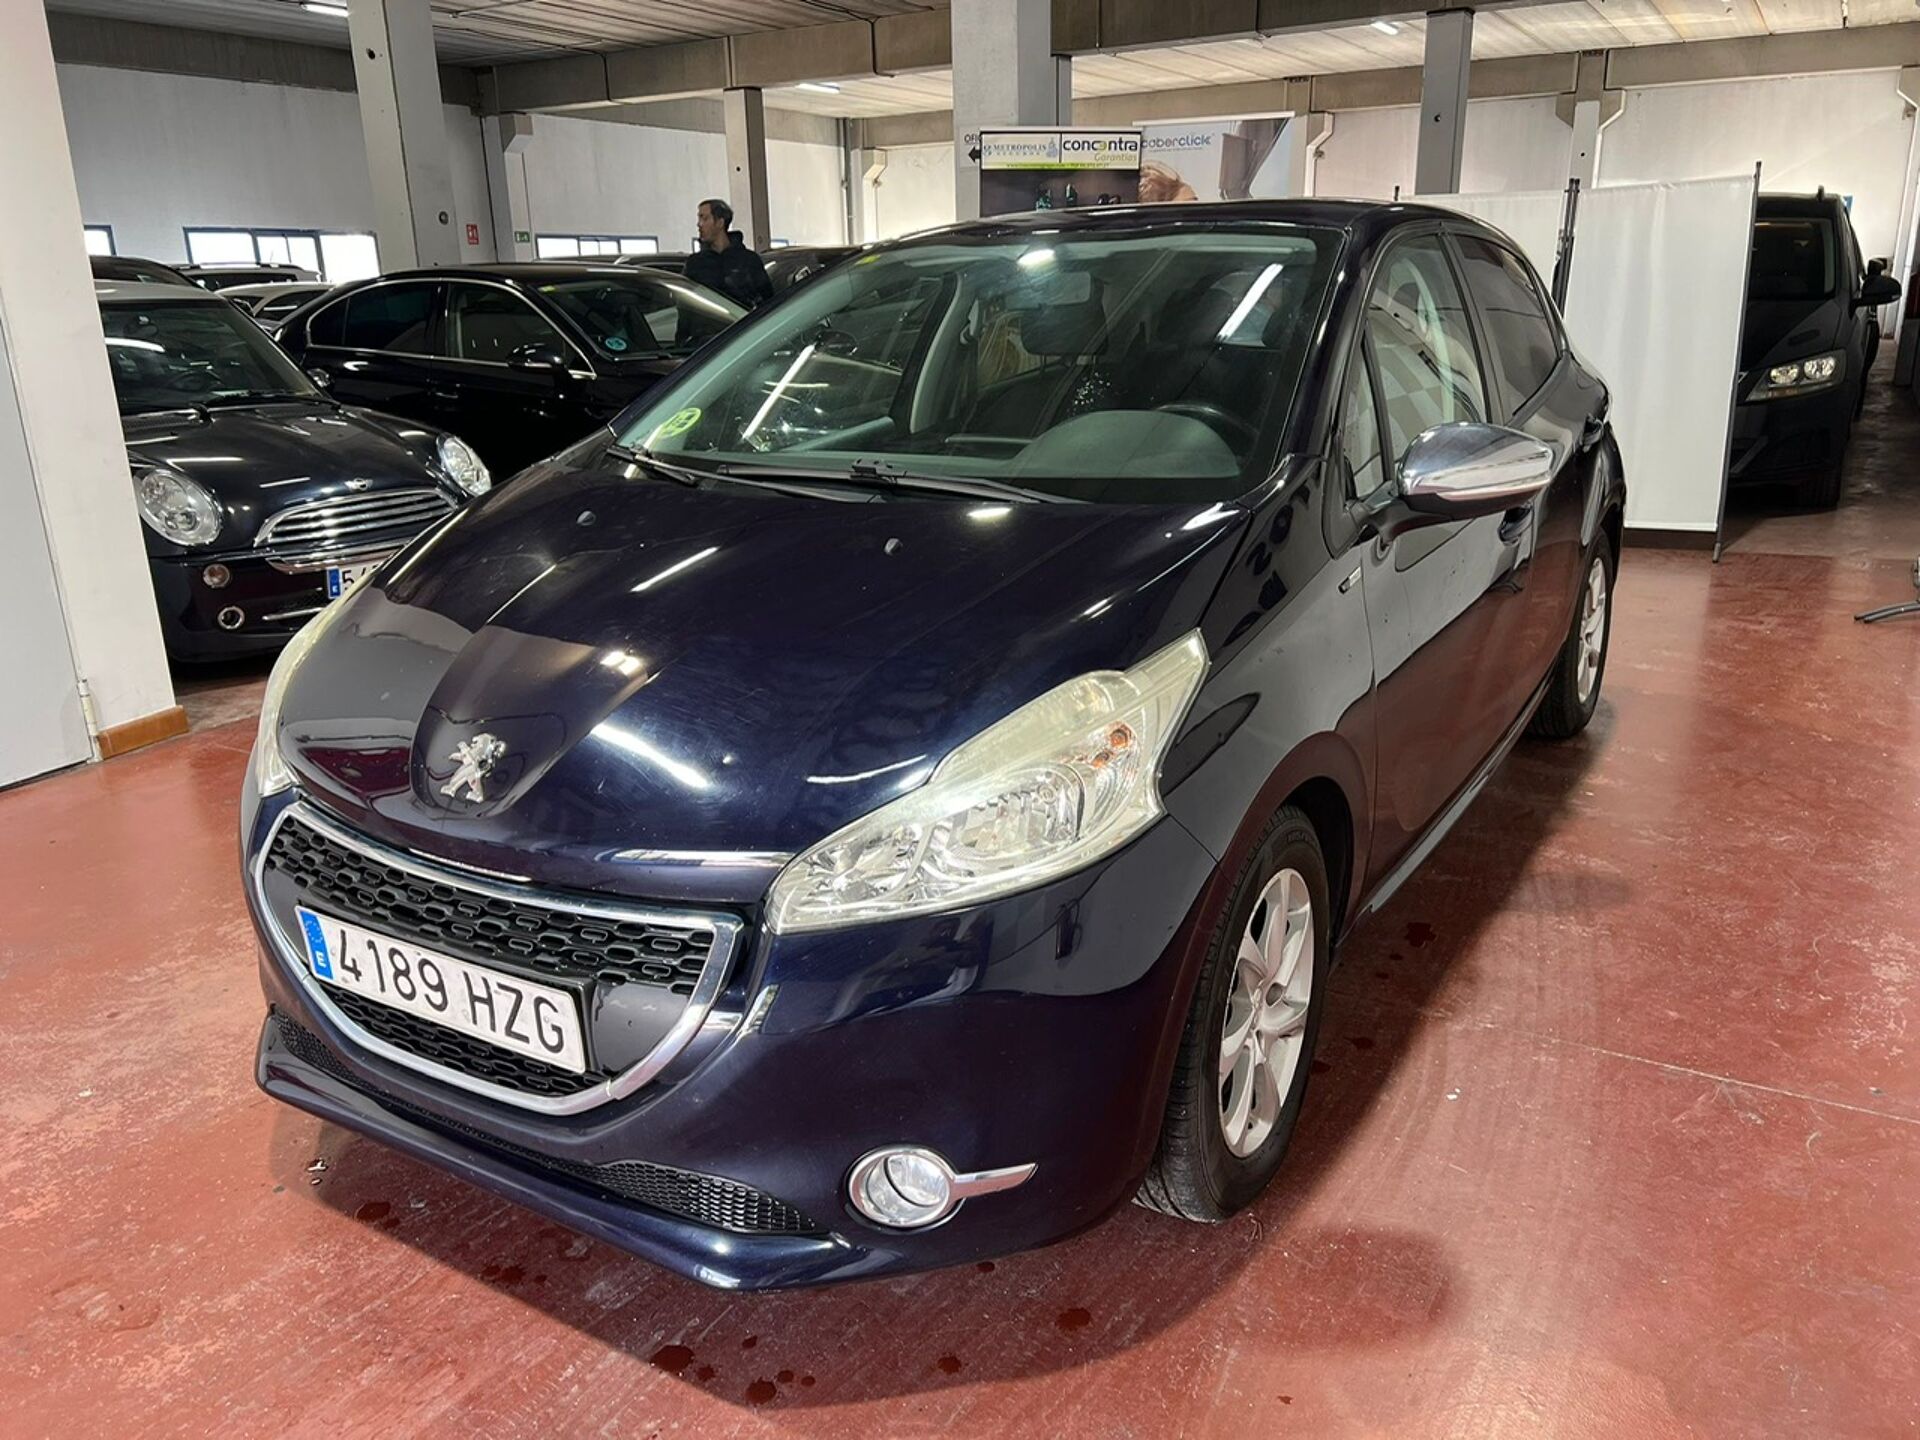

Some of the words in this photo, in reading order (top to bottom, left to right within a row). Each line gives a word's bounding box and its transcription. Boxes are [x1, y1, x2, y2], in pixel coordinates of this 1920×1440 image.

[1063, 136, 1138, 151] concentra
[316, 953, 327, 968] E
[339, 929, 449, 1012] 4189
[462, 970, 564, 1053] HZG
